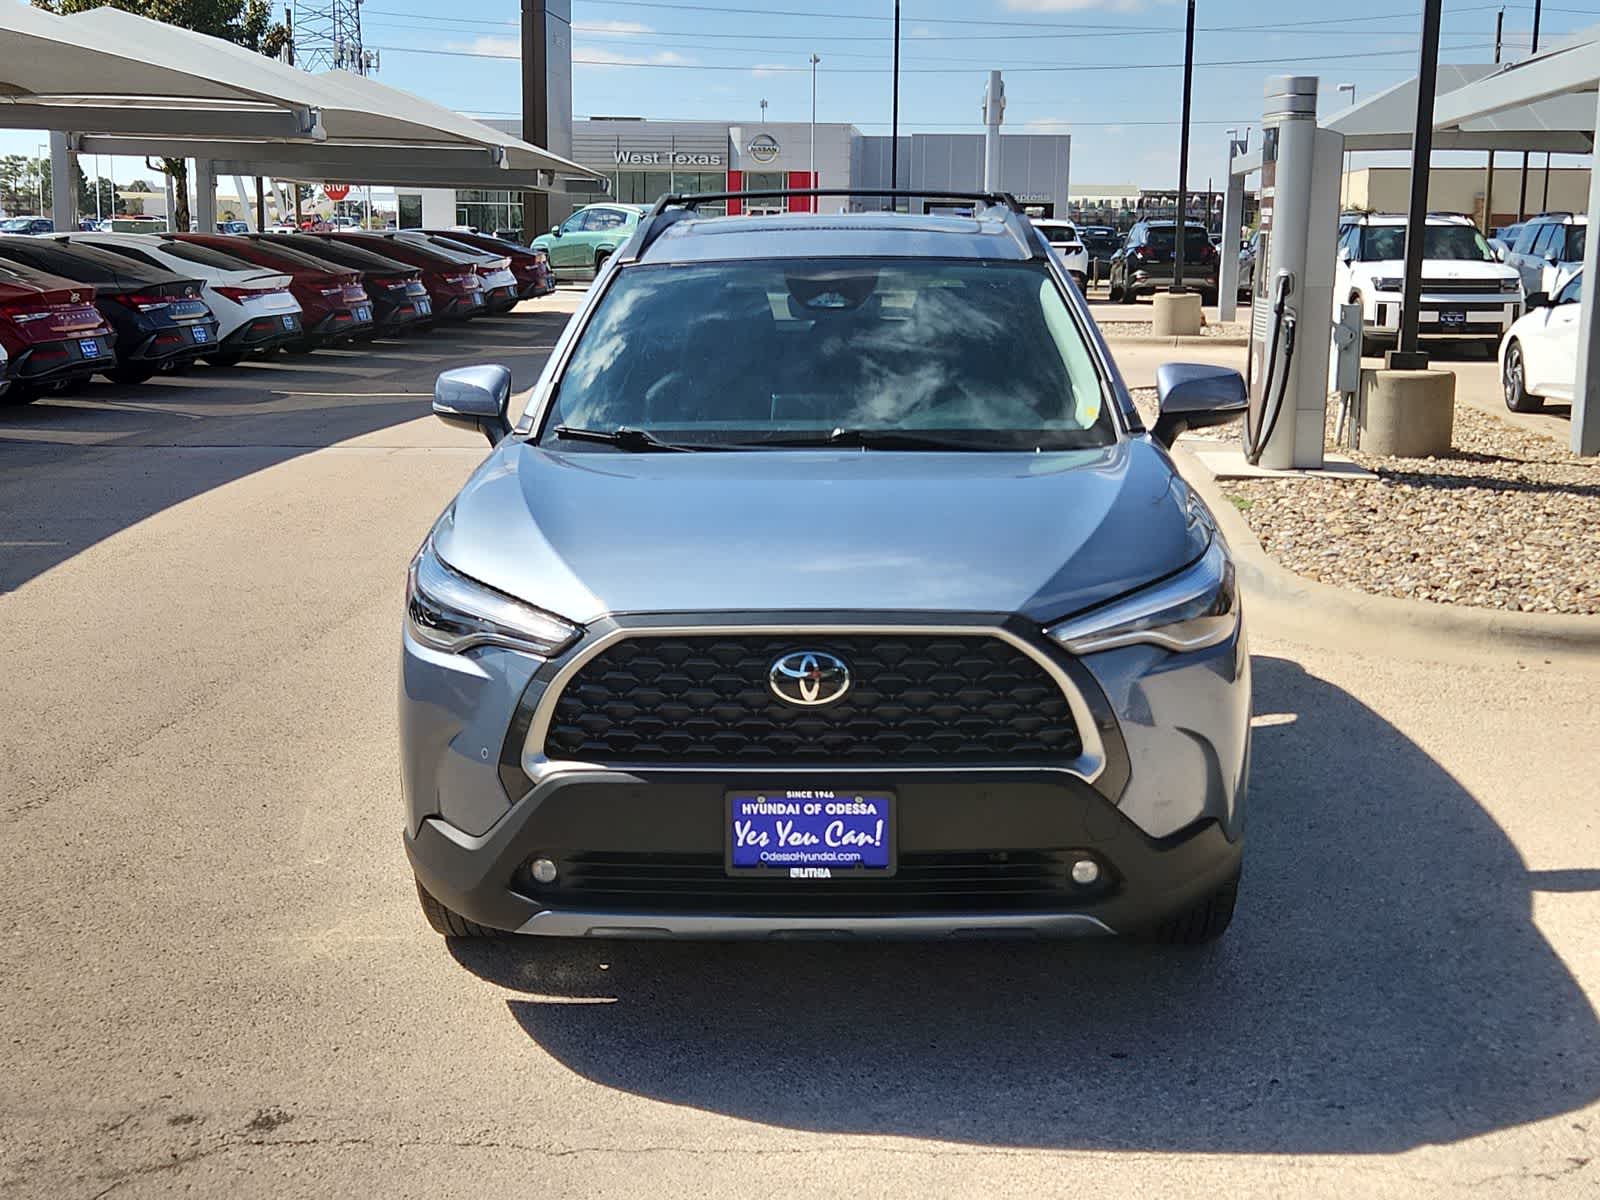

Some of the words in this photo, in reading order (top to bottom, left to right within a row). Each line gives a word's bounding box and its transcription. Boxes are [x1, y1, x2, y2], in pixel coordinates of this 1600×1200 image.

[614, 151, 660, 165] West
[665, 151, 721, 165] Texas
[786, 790, 812, 799] SINCE
[815, 790, 835, 799] 1946
[742, 803, 800, 815] HYUNDAI
[803, 803, 822, 815] OF
[825, 803, 877, 815] ODESSA
[734, 820, 770, 847] Yes
[776, 820, 819, 847] You
[825, 819, 884, 847] Can!
[760, 850, 861, 863] OdessaHyundai.com
